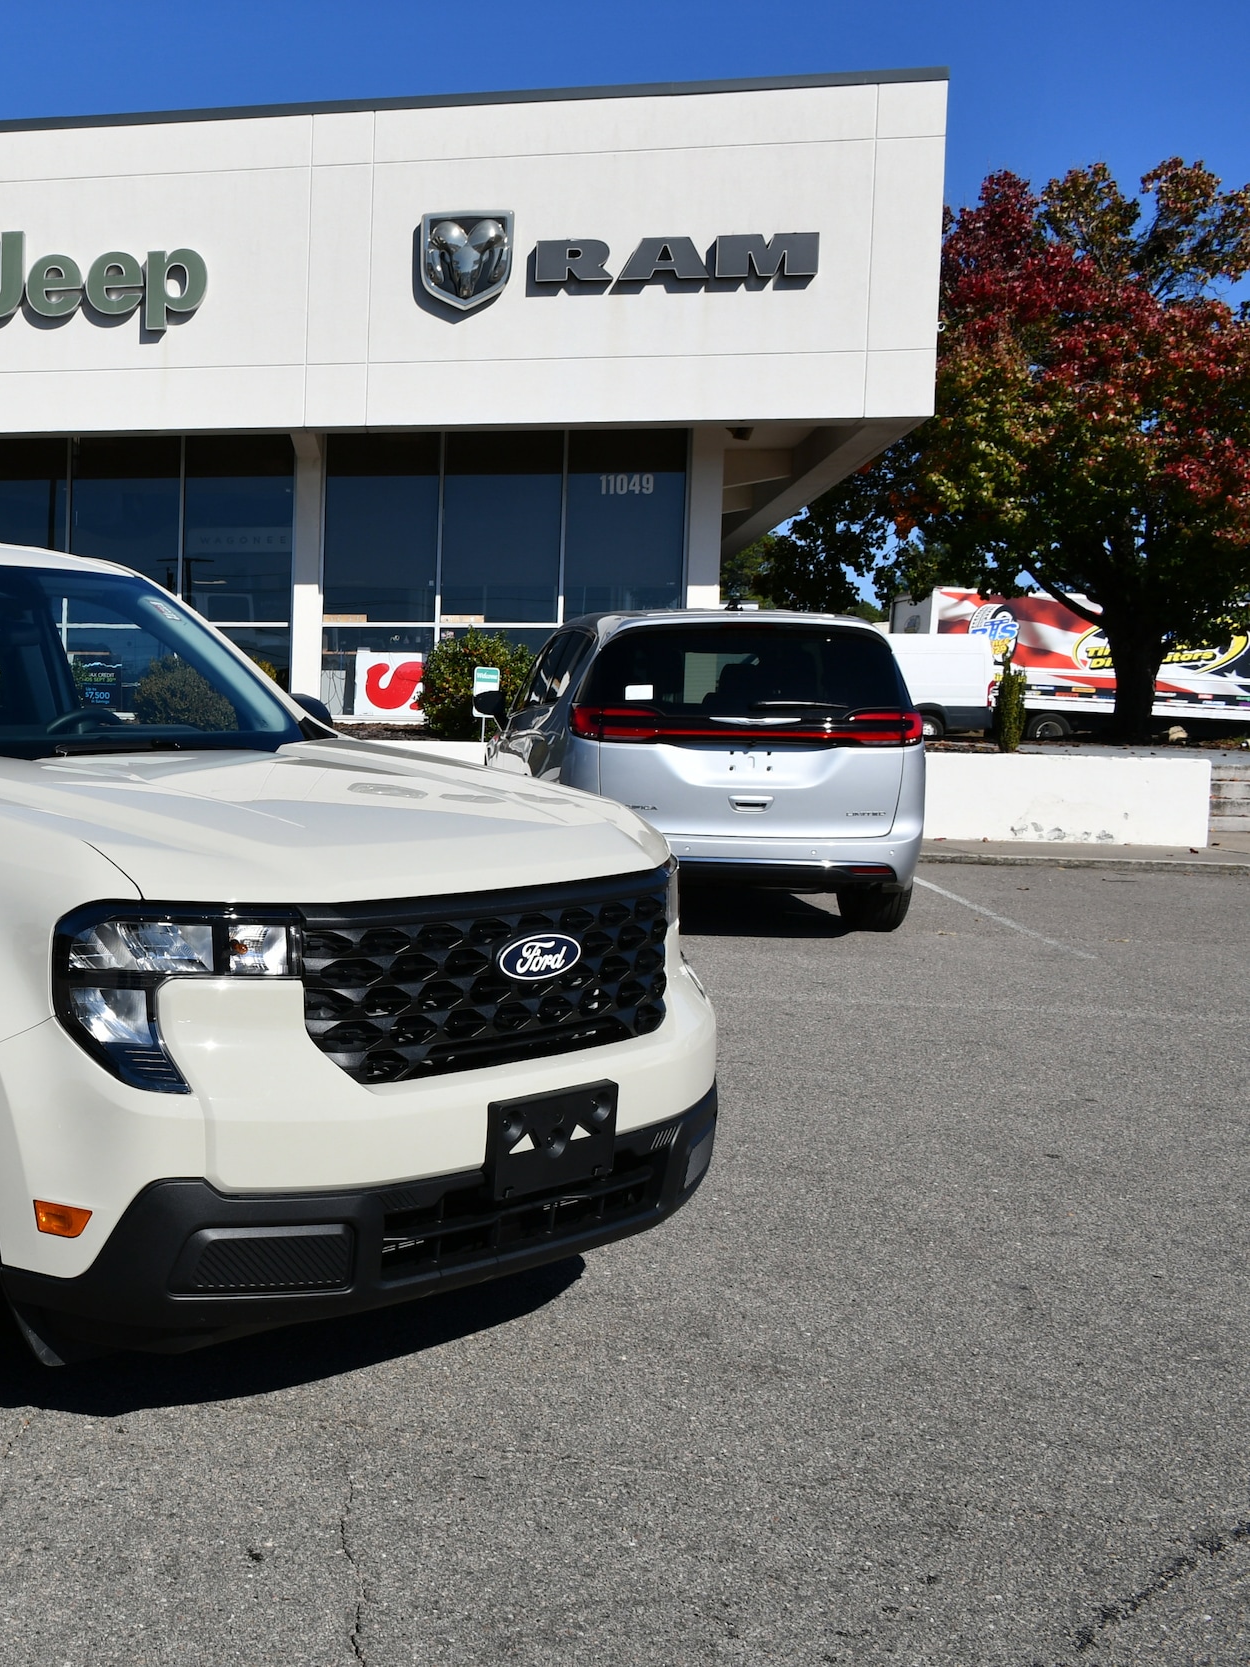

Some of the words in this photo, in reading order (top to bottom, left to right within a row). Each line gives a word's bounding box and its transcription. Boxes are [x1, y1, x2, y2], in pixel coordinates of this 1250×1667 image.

[534, 231, 820, 283] RAM
[599, 473, 654, 495] 11049
[199, 535, 287, 545] WAGONEE
[85, 692, 110, 700] $7,500
[516, 940, 568, 974] Ford
